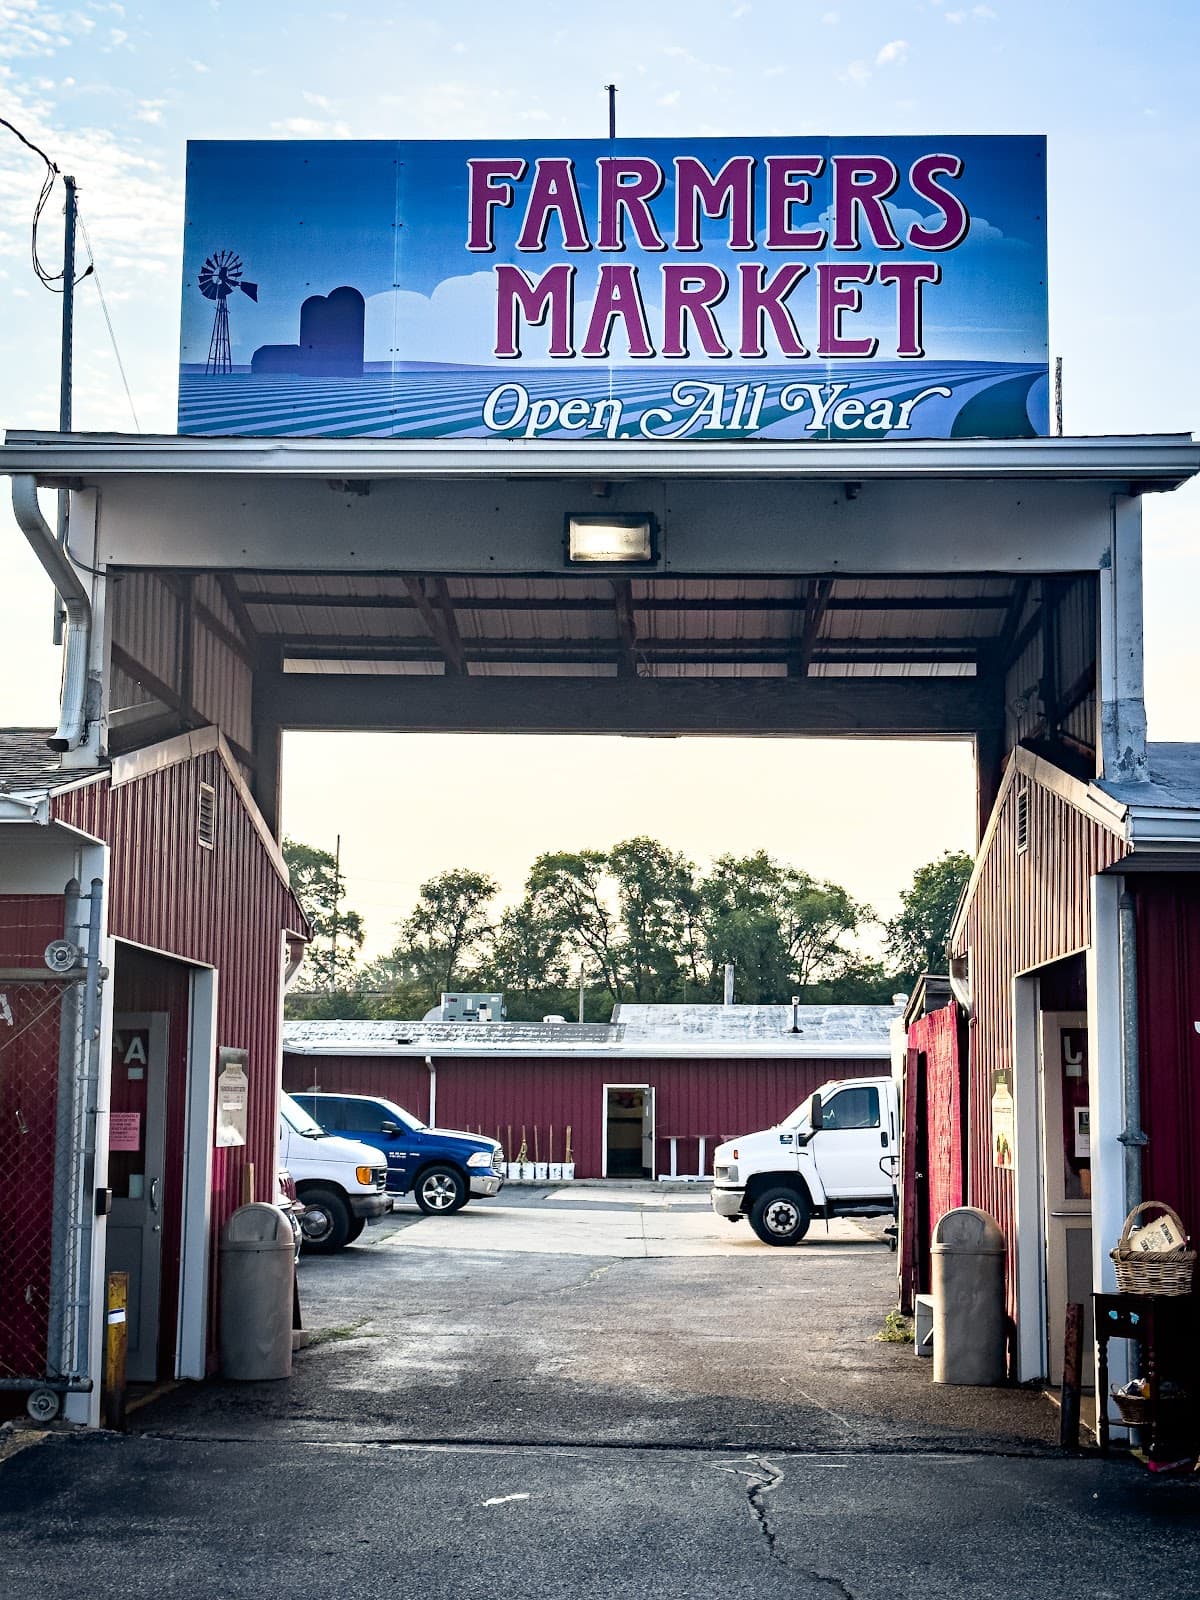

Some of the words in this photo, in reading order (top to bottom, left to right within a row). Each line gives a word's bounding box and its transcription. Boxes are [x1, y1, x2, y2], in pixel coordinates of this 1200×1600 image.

[465, 153, 970, 253] FARMERS
[493, 261, 943, 359] MARKET
[482, 381, 630, 439] Open
[639, 379, 767, 439] All
[780, 381, 952, 431] Year
